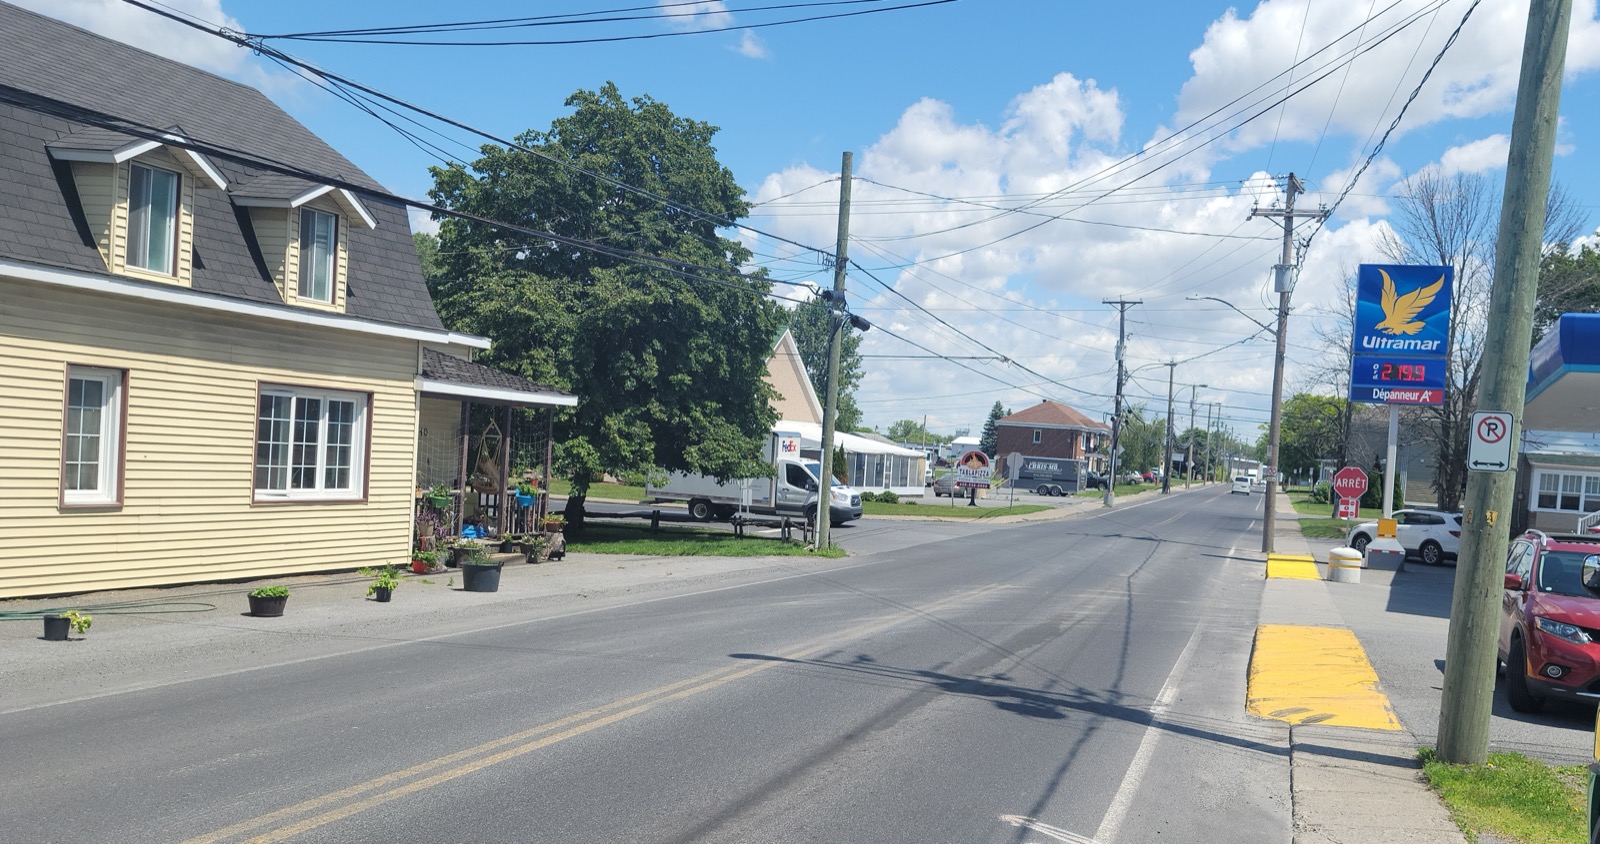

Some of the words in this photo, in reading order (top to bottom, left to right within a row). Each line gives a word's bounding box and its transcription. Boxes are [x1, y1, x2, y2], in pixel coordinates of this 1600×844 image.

[1362, 336, 1440, 350] Ultramar
[1372, 387, 1420, 402] Dépanneur
[782, 440, 797, 453] FedEx
[1335, 477, 1367, 489] ARRÊT
